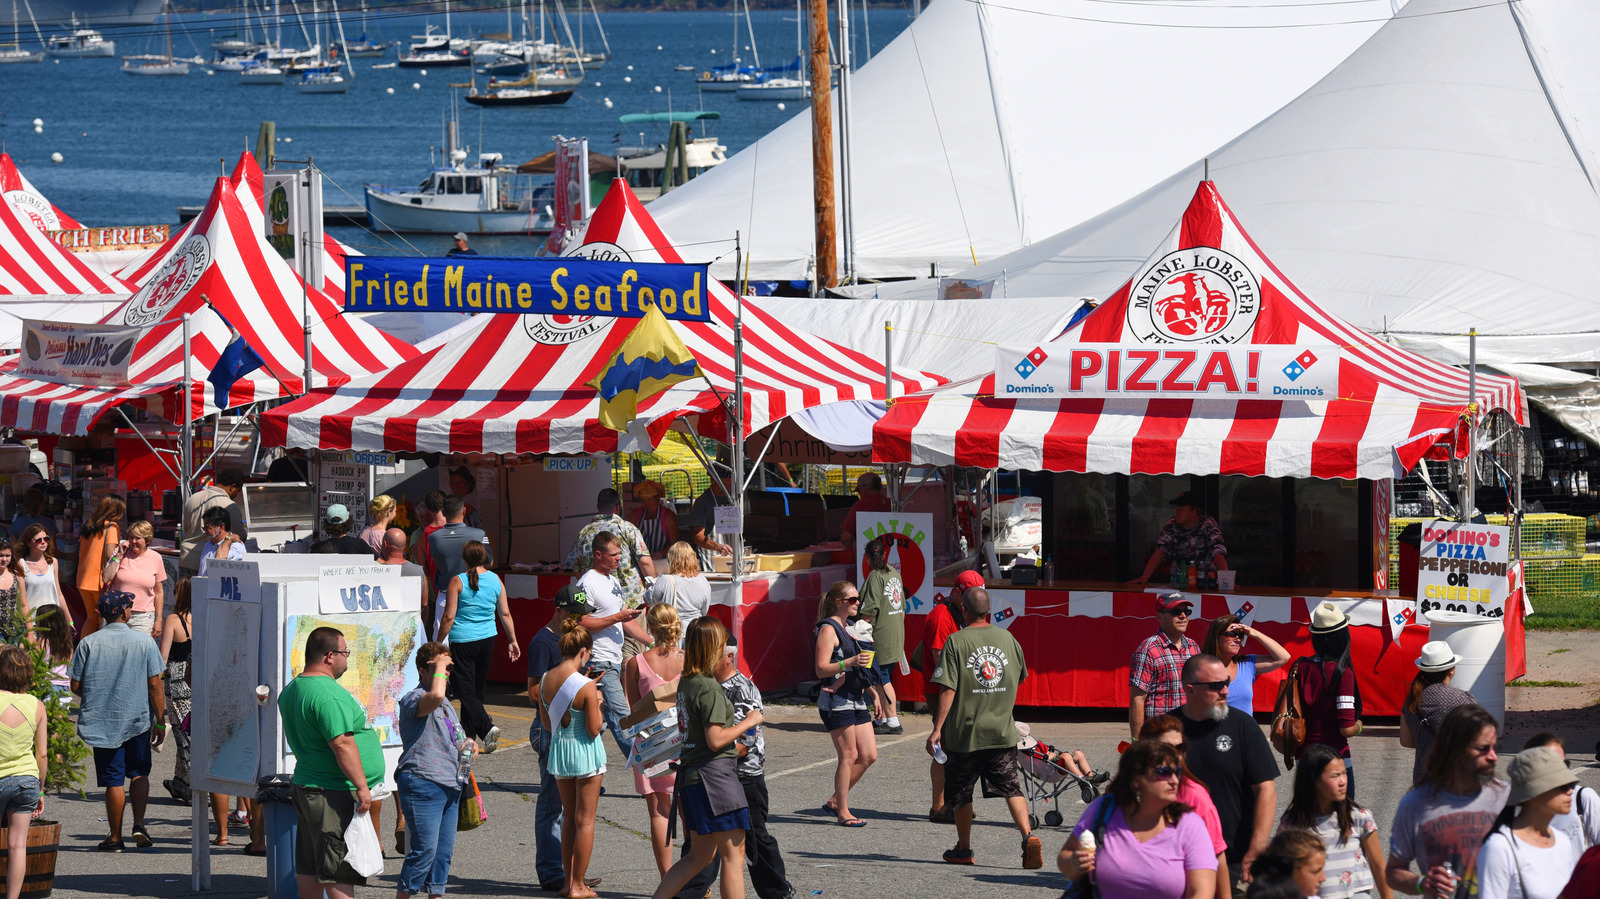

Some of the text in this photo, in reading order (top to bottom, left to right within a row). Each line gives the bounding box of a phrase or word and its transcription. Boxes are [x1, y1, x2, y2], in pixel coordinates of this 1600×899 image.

[13, 194, 56, 224] LOBSTER
[99, 226, 165, 246] FRIES
[350, 263, 703, 316] Fried Maine Seafood
[1135, 255, 1254, 315] MAINE LOBSTER
[529, 321, 600, 343] FESTIVAL
[63, 335, 93, 365] Hand
[87, 336, 114, 367] Pies
[1068, 349, 1262, 395] PIZZA!
[1006, 383, 1054, 393] Domino's
[1273, 385, 1324, 396] Domino's
[354, 453, 387, 465] ORDER
[335, 481, 354, 491] SHRIMP
[328, 494, 355, 506] SCALLOPS
[863, 520, 926, 546] WATER
[1424, 528, 1500, 547] DOMINO'S
[1436, 543, 1487, 560] PIZZA
[322, 567, 342, 577] WHERE
[345, 567, 355, 575] ARE
[359, 567, 369, 575] YOU
[1420, 557, 1508, 577] PEPPERONI
[220, 576, 241, 600] ME
[1447, 573, 1469, 587] OR
[340, 584, 389, 612] USA
[1425, 584, 1491, 603] CHEESE
[966, 645, 1009, 669] VOLUNTEER
